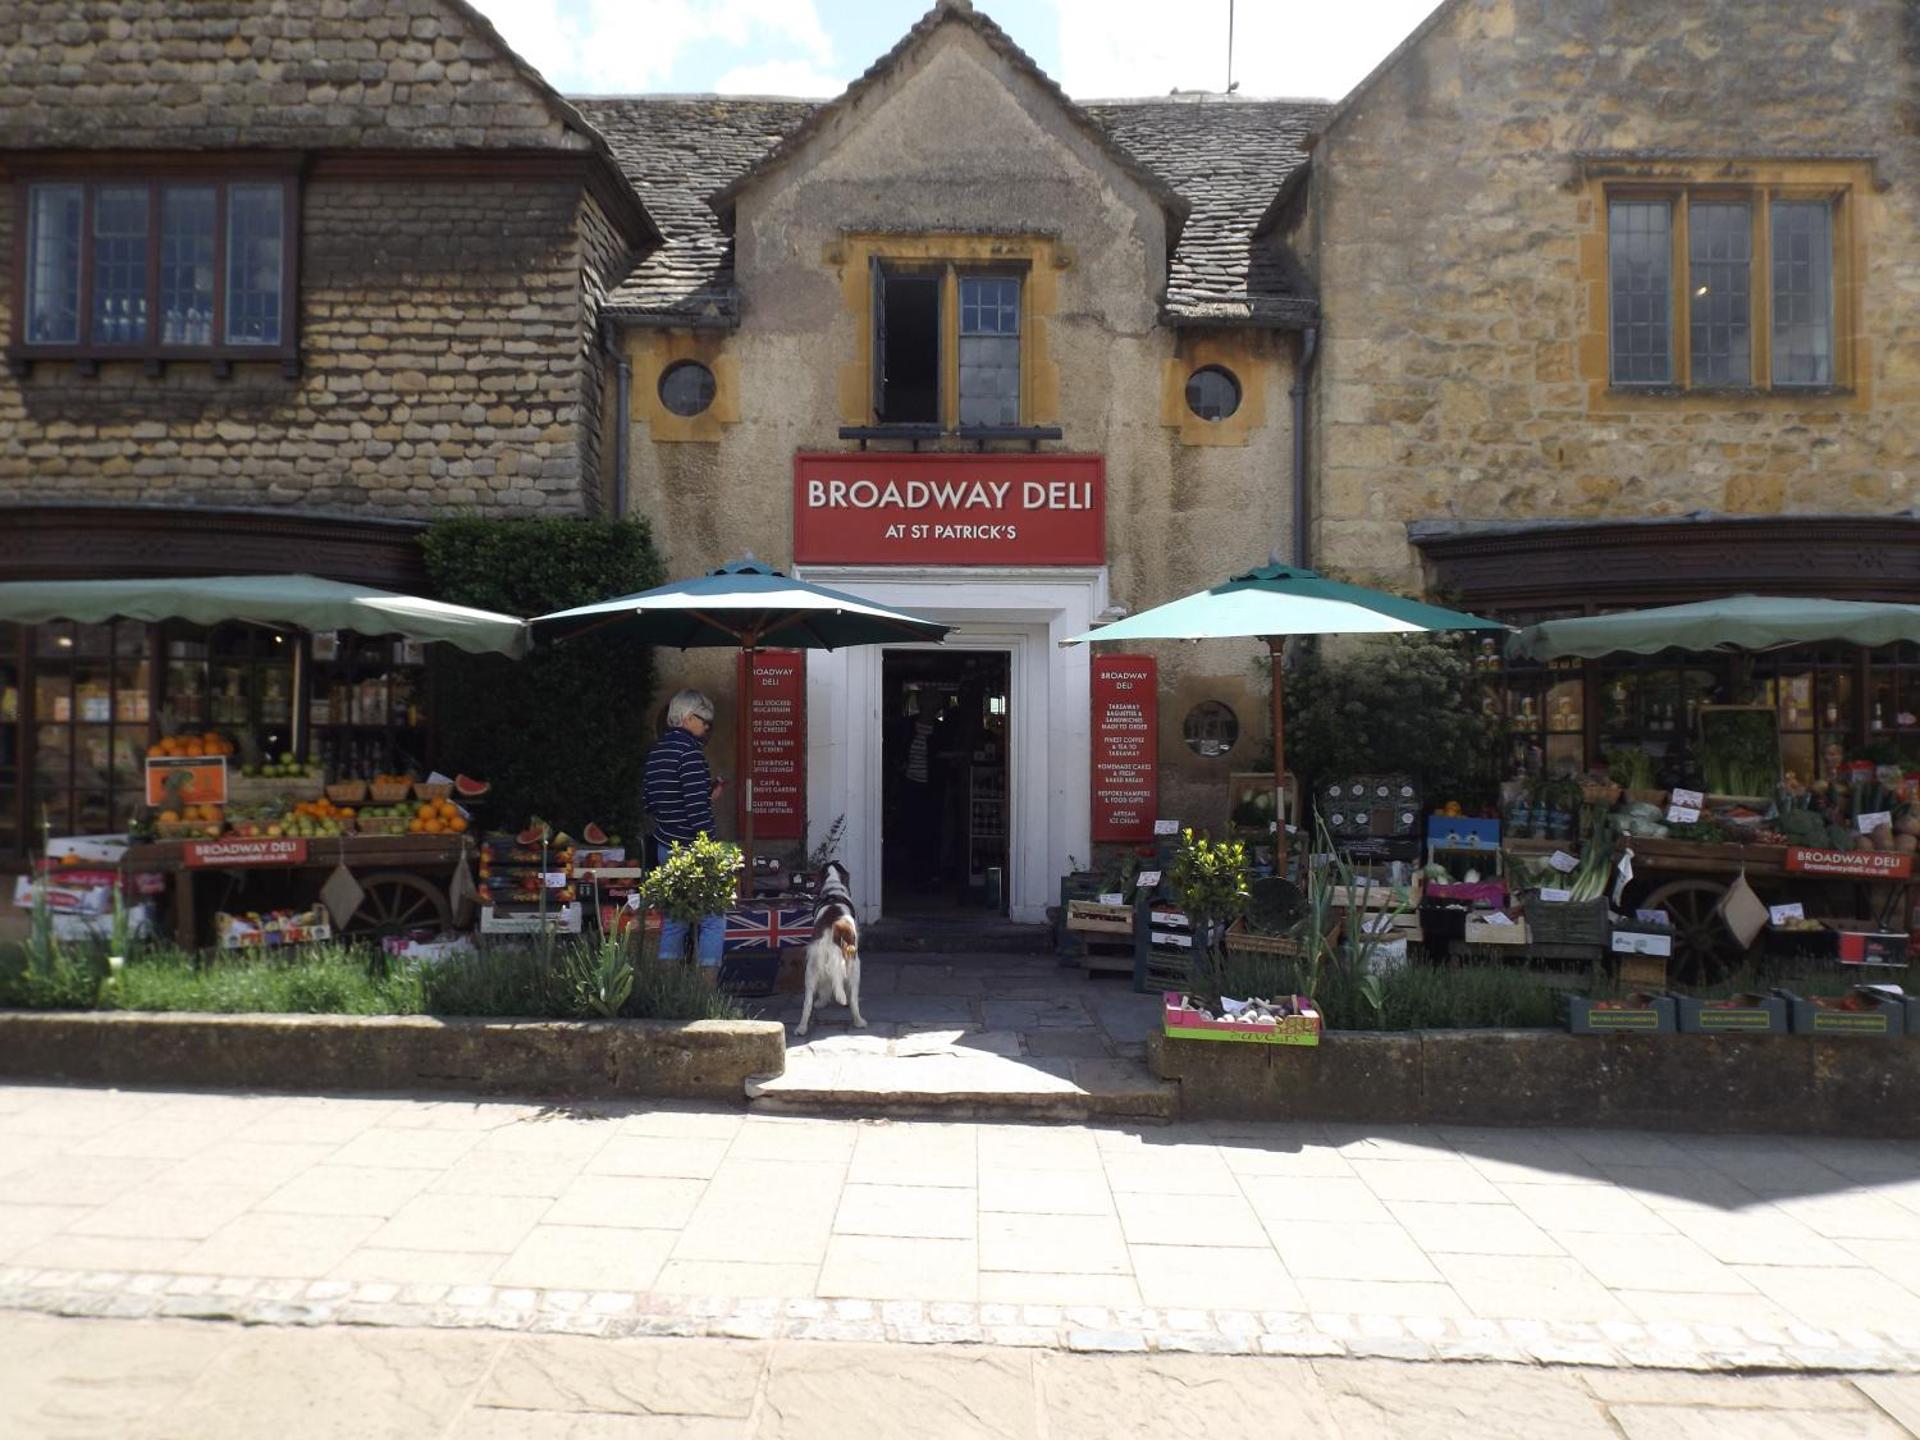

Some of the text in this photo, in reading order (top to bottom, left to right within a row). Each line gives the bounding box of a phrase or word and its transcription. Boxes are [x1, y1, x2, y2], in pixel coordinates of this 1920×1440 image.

[808, 480, 1092, 510] BROADWAY DELI
[885, 524, 1016, 540] AT ST PATRICK'S
[762, 677, 779, 686] DELI
[1101, 672, 1148, 680] BROADWAY
[1116, 681, 1133, 690] DELI
[195, 841, 297, 856] BROADWAY DELI
[1797, 850, 1901, 868] BROADWAY DELI
